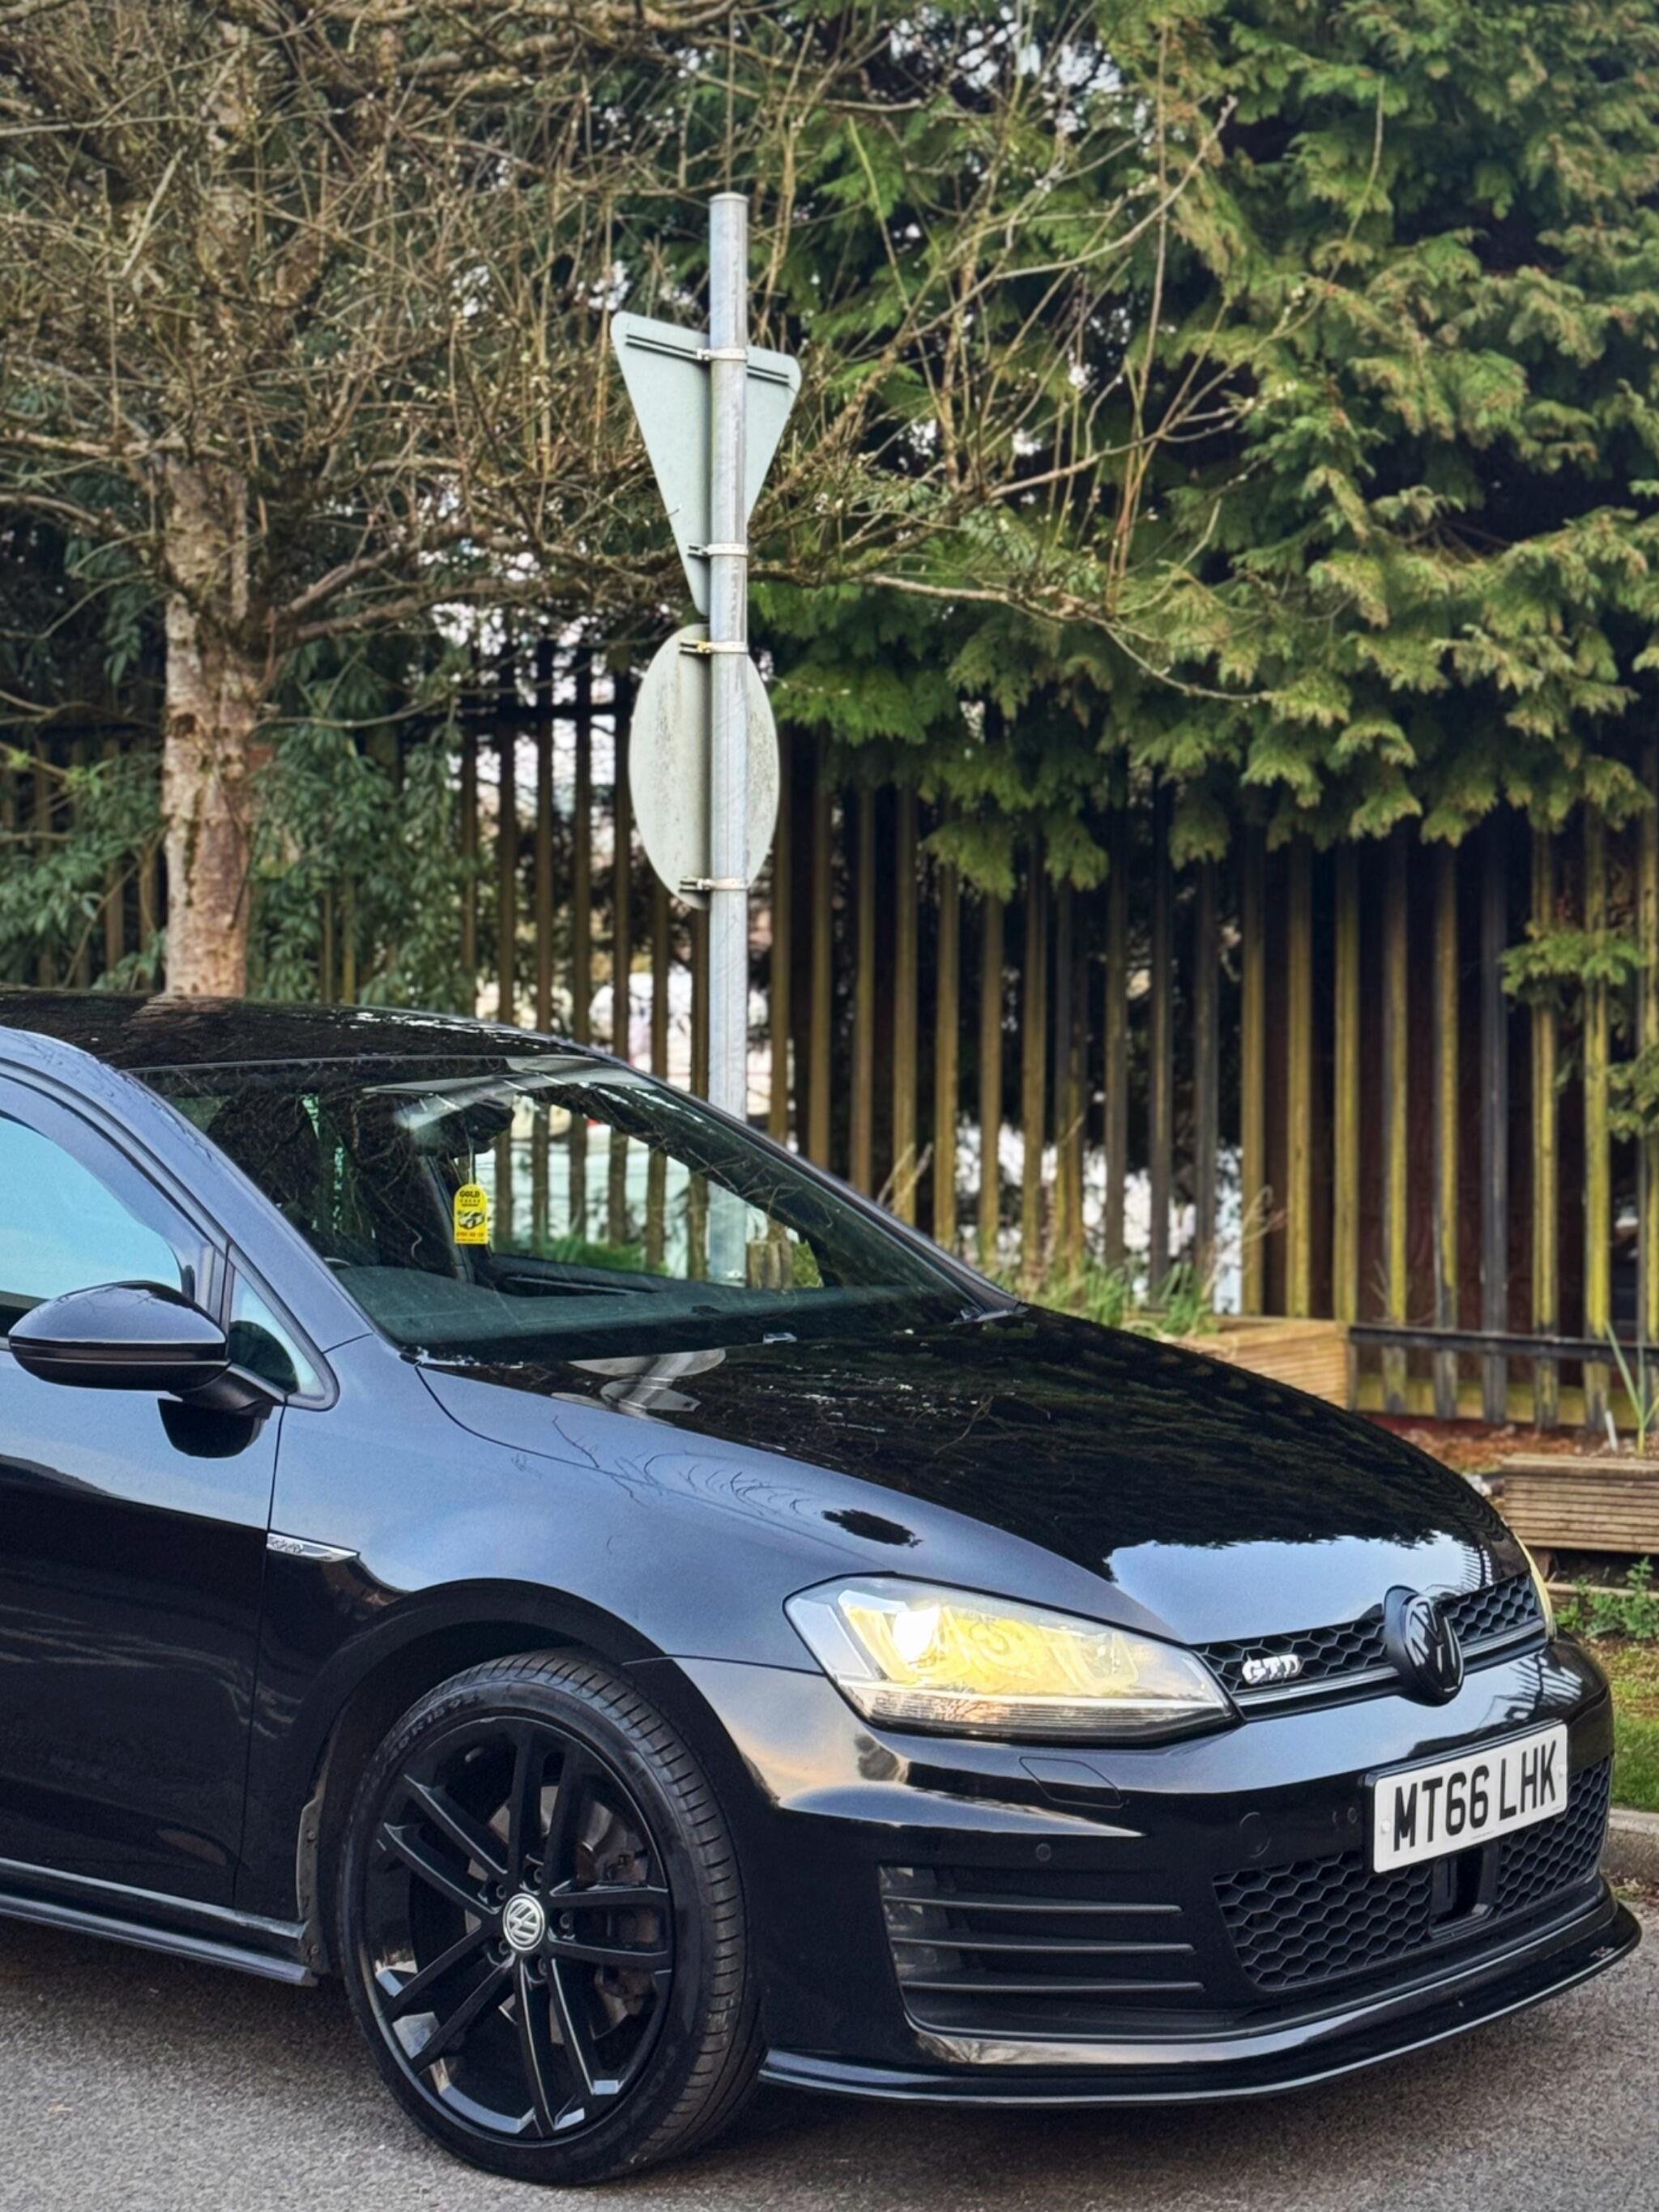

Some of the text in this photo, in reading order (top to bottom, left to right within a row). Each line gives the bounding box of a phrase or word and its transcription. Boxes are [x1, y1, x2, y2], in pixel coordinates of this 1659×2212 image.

[459, 1190, 480, 1198] GOLD
[1242, 1654, 1301, 1685] GTD
[1392, 1740, 1557, 1852] MT66 LHK
